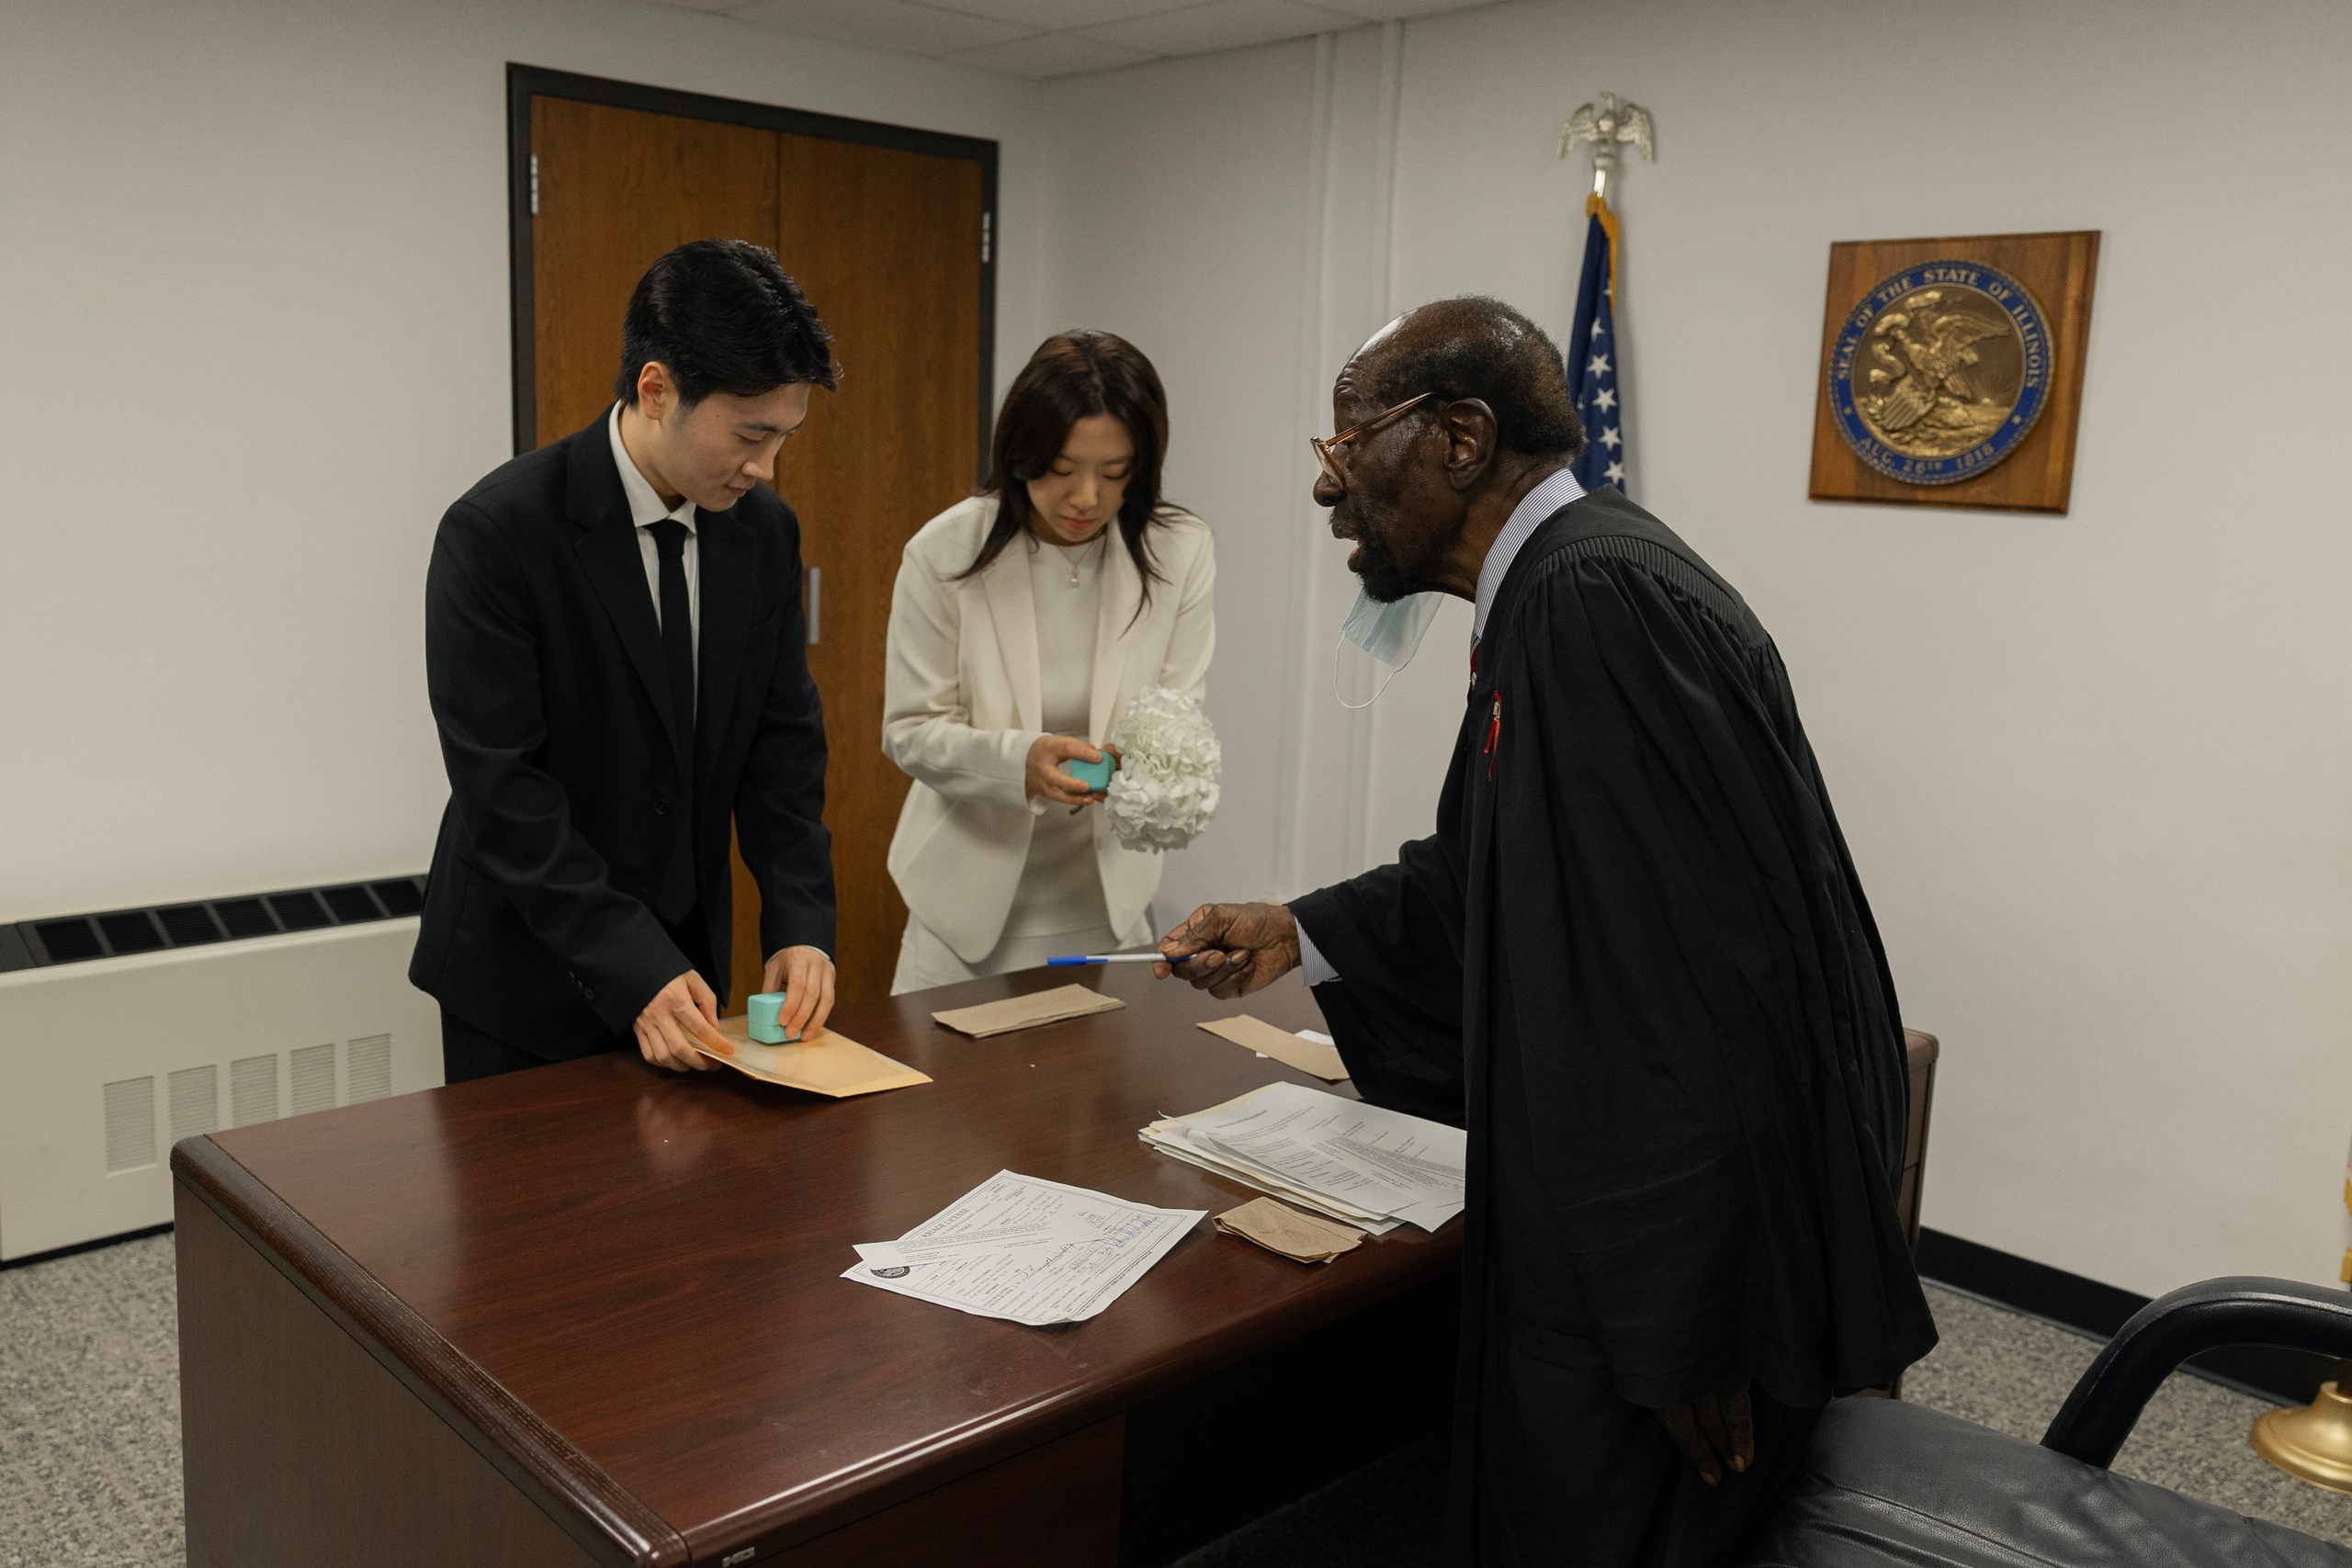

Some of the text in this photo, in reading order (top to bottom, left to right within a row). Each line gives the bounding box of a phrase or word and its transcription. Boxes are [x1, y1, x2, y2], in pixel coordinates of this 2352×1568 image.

[1838, 268, 2043, 389] SEAL OF THE STATE OF ILLINOIS
